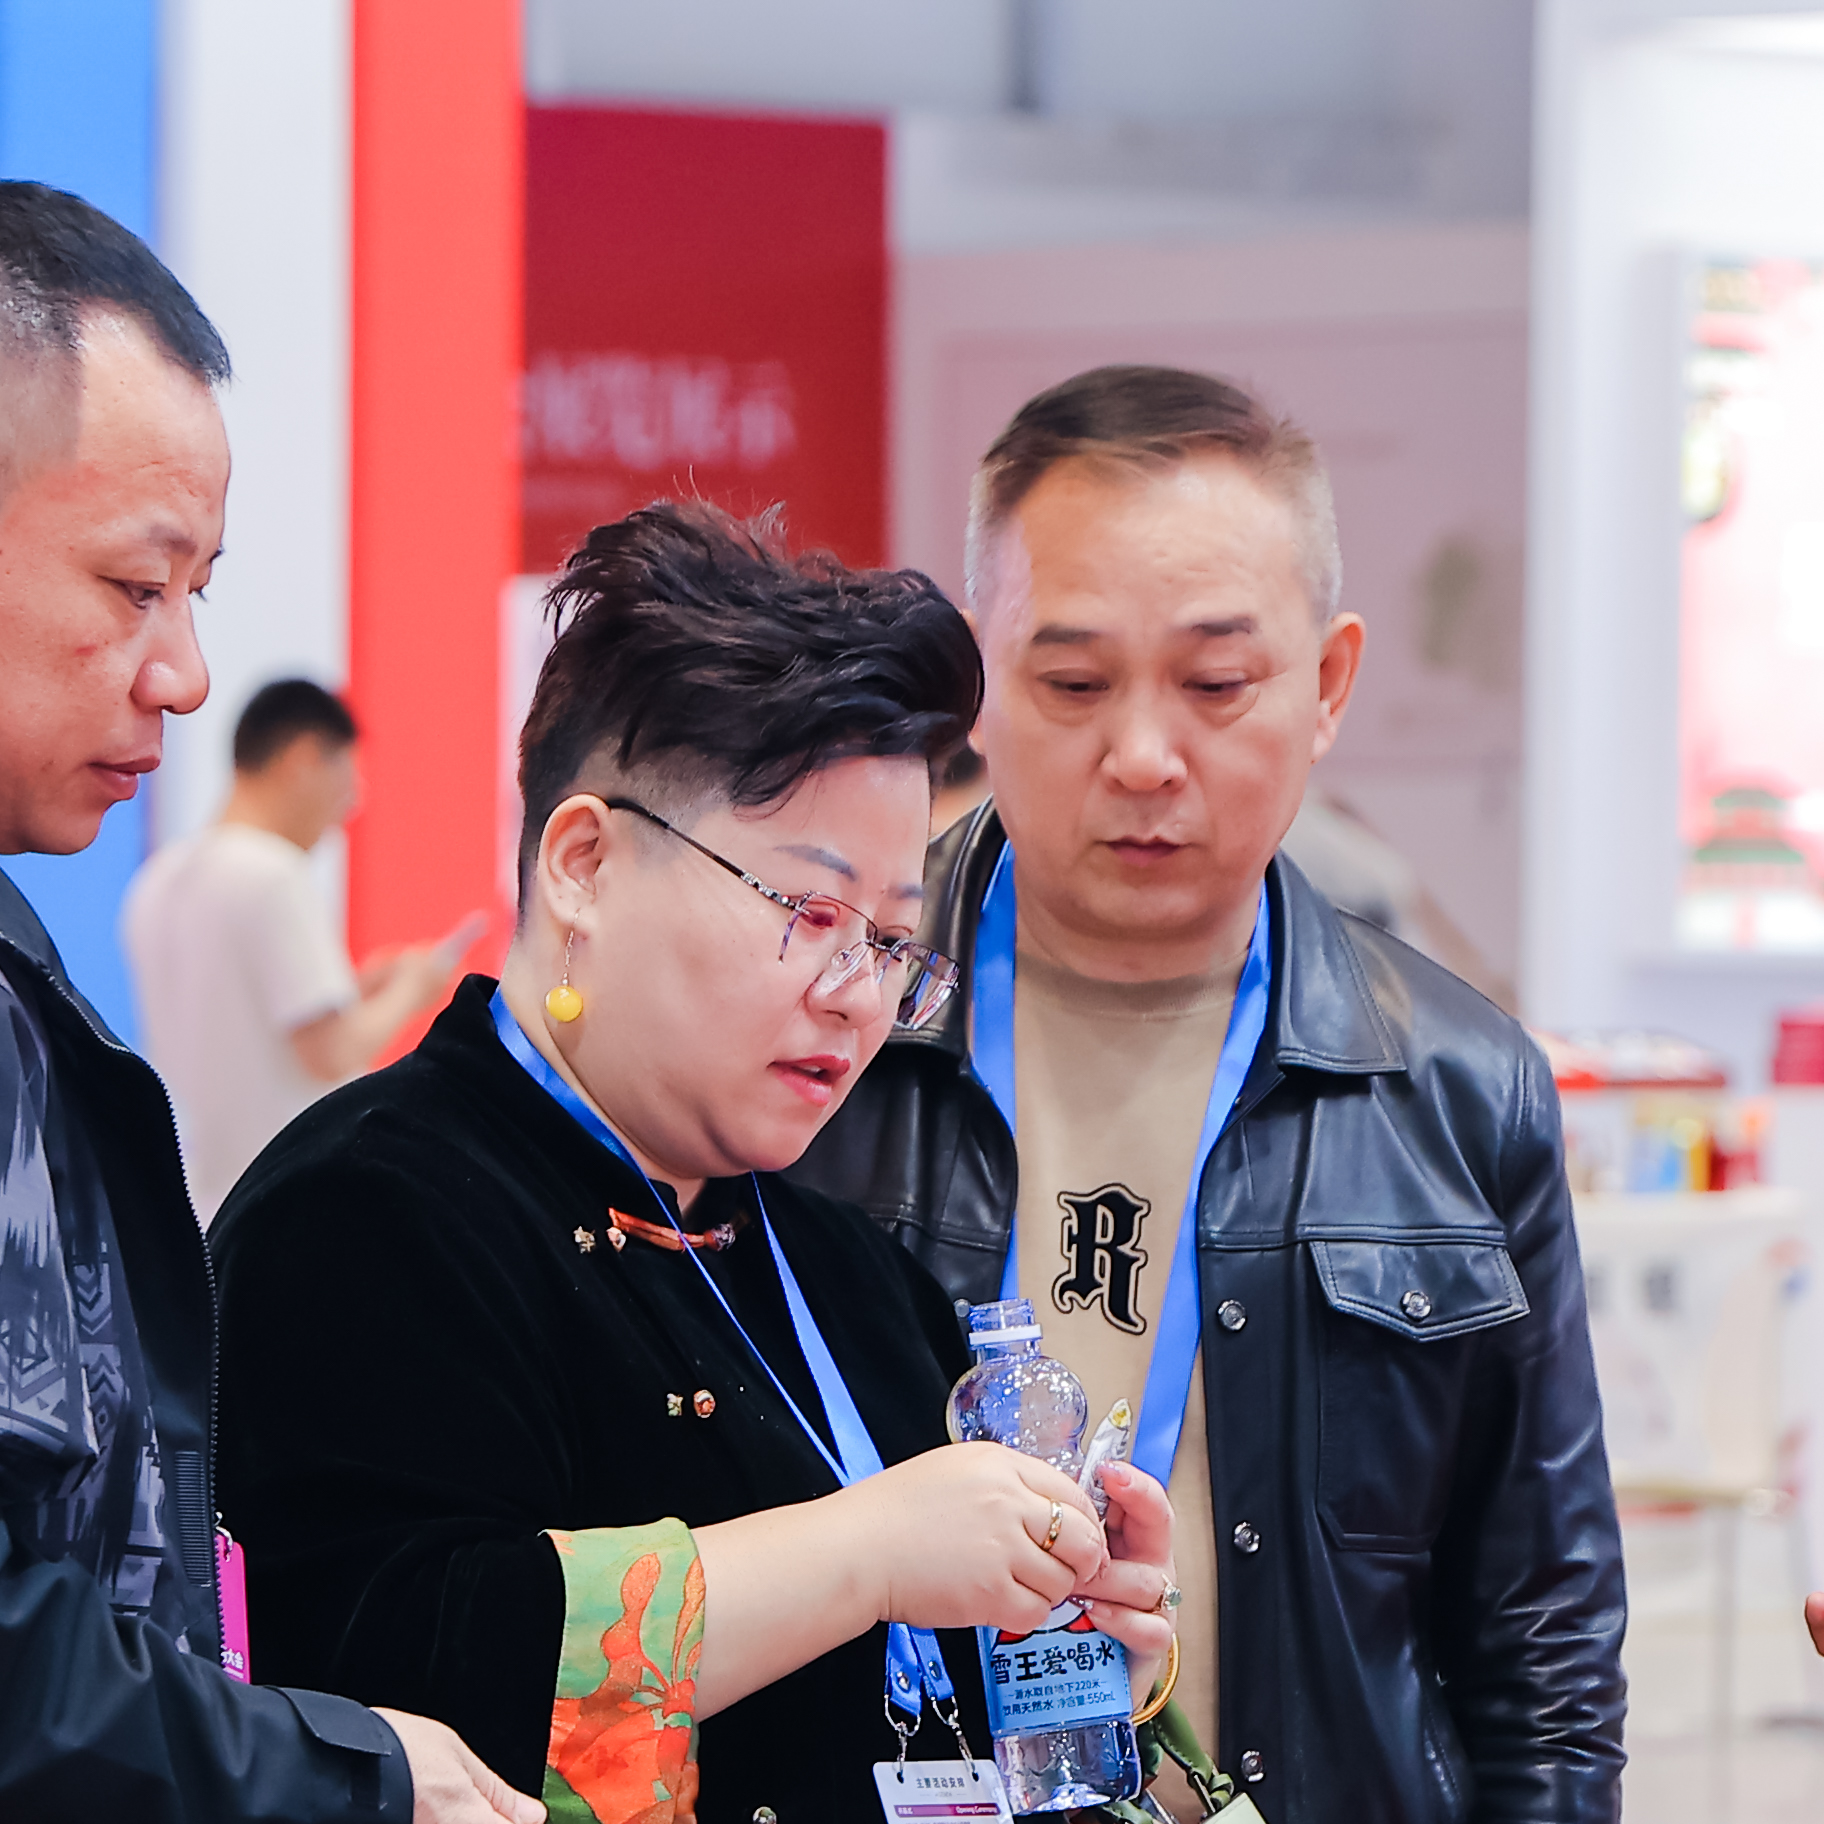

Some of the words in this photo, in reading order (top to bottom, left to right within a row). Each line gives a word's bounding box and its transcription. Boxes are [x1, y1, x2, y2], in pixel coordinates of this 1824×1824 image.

[1052, 1183, 1151, 1335] R
[990, 1641, 1115, 1685] 雪王爱喝水
